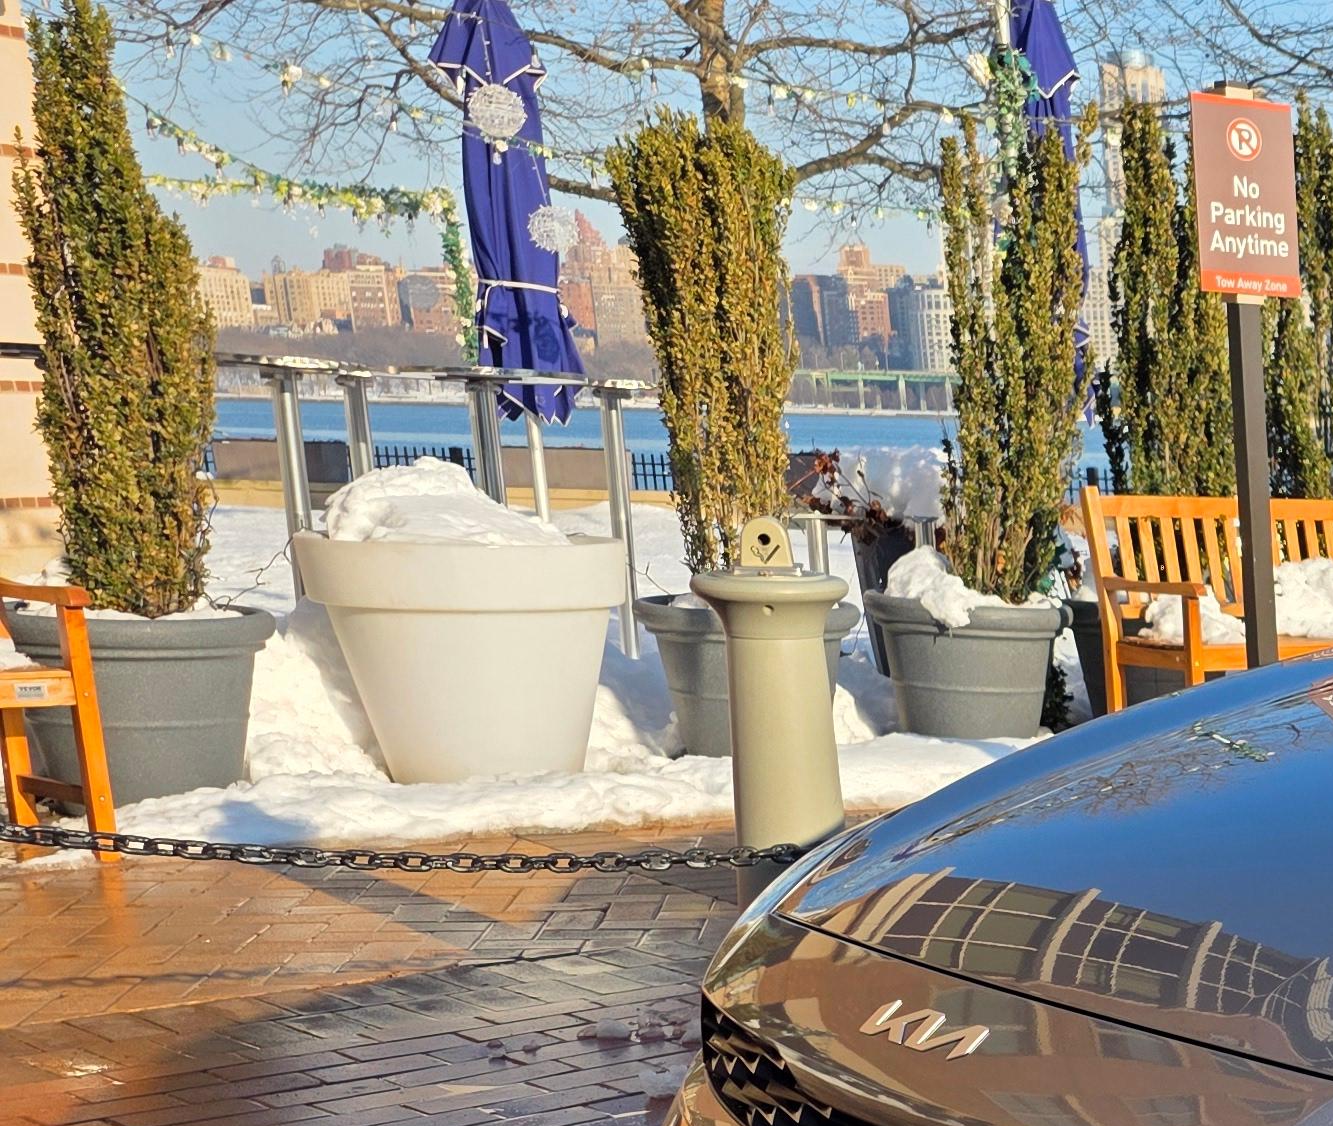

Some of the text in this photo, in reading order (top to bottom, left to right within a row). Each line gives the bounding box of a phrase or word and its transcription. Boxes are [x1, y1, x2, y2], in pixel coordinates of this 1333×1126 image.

[1233, 175, 1260, 199] No
[1210, 201, 1285, 235] Parking
[1210, 229, 1289, 259] Anytime
[1215, 275, 1288, 293] Tow Away Zone
[860, 1000, 989, 1061] KIA
